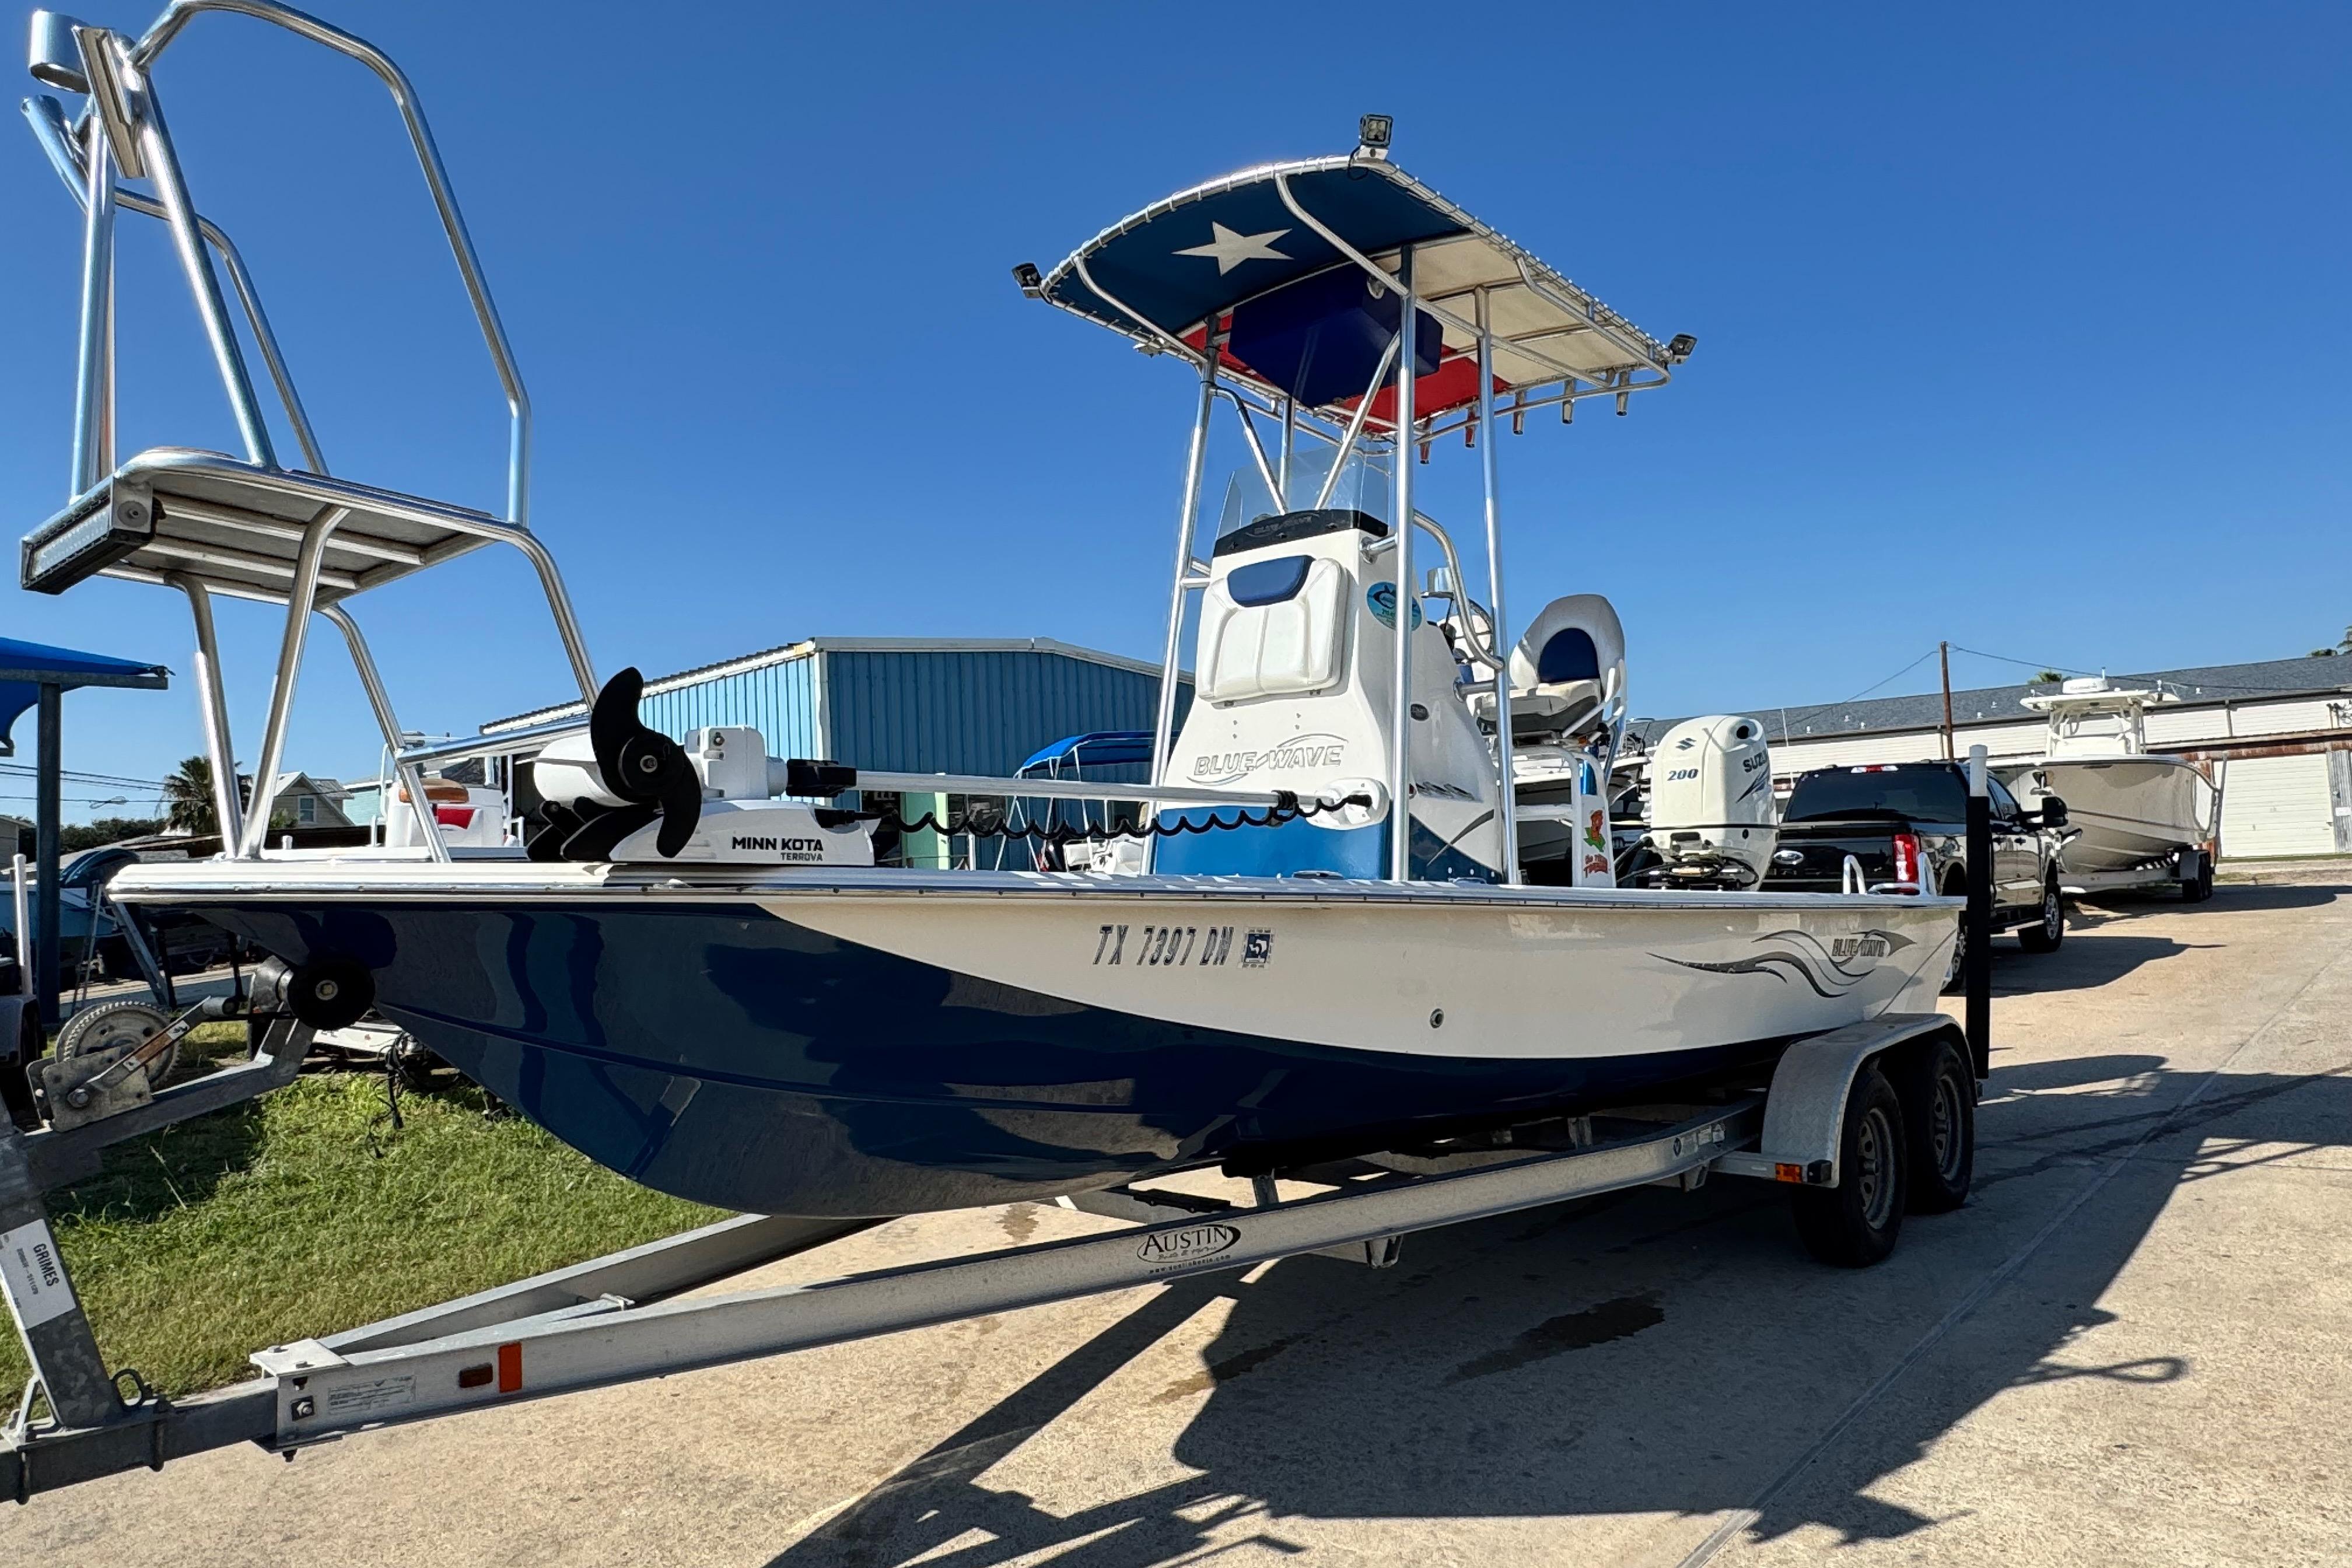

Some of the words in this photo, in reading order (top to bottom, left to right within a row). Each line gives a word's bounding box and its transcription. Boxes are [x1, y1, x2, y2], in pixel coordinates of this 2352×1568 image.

[1194, 751, 1258, 776] BLUE
[1268, 745, 1344, 770] WAVE
[1667, 768, 1699, 781] 200
[732, 836, 777, 850] MINN
[781, 838, 824, 851] KOTA
[780, 852, 823, 862] TERROVA
[1093, 924, 1129, 965] TX
[1832, 938, 1859, 957] BLUE
[1143, 1226, 1228, 1256] AUSTIN
[33, 1242, 60, 1287] GRIMES
